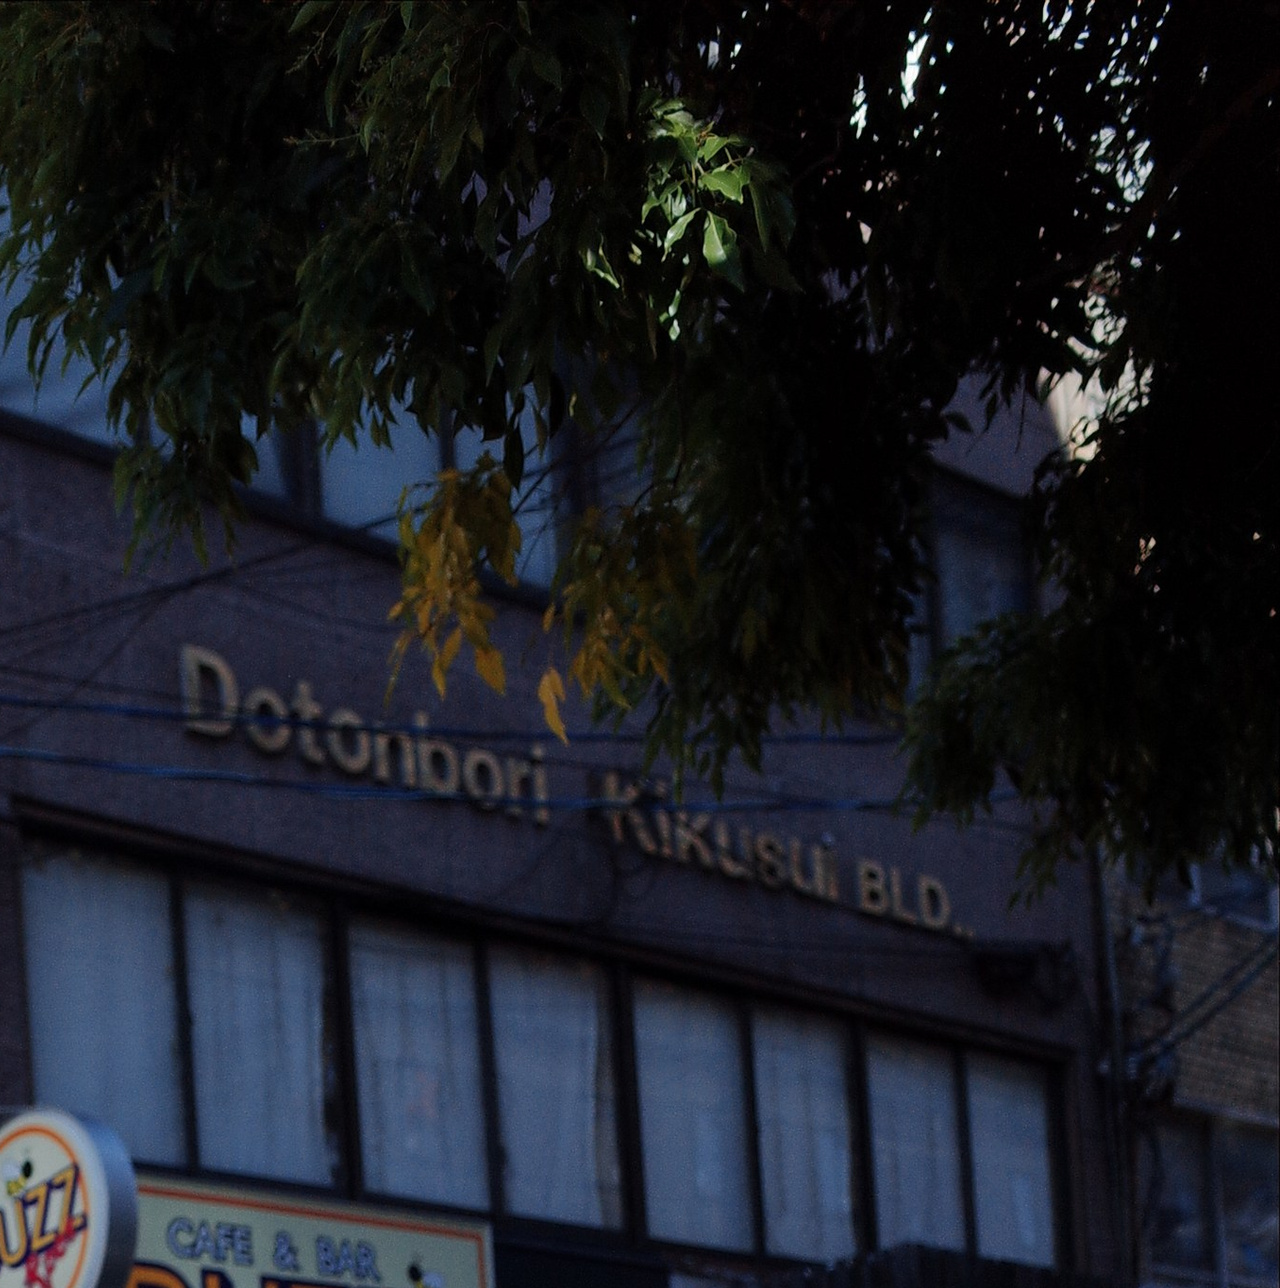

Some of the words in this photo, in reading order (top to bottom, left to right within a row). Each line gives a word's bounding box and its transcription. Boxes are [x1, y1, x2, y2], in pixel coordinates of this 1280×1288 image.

[179, 643, 550, 827] Dotonbori
[166, 1217, 255, 1267] CAFE
[272, 1229, 300, 1273] &
[316, 1235, 383, 1284] BAR
